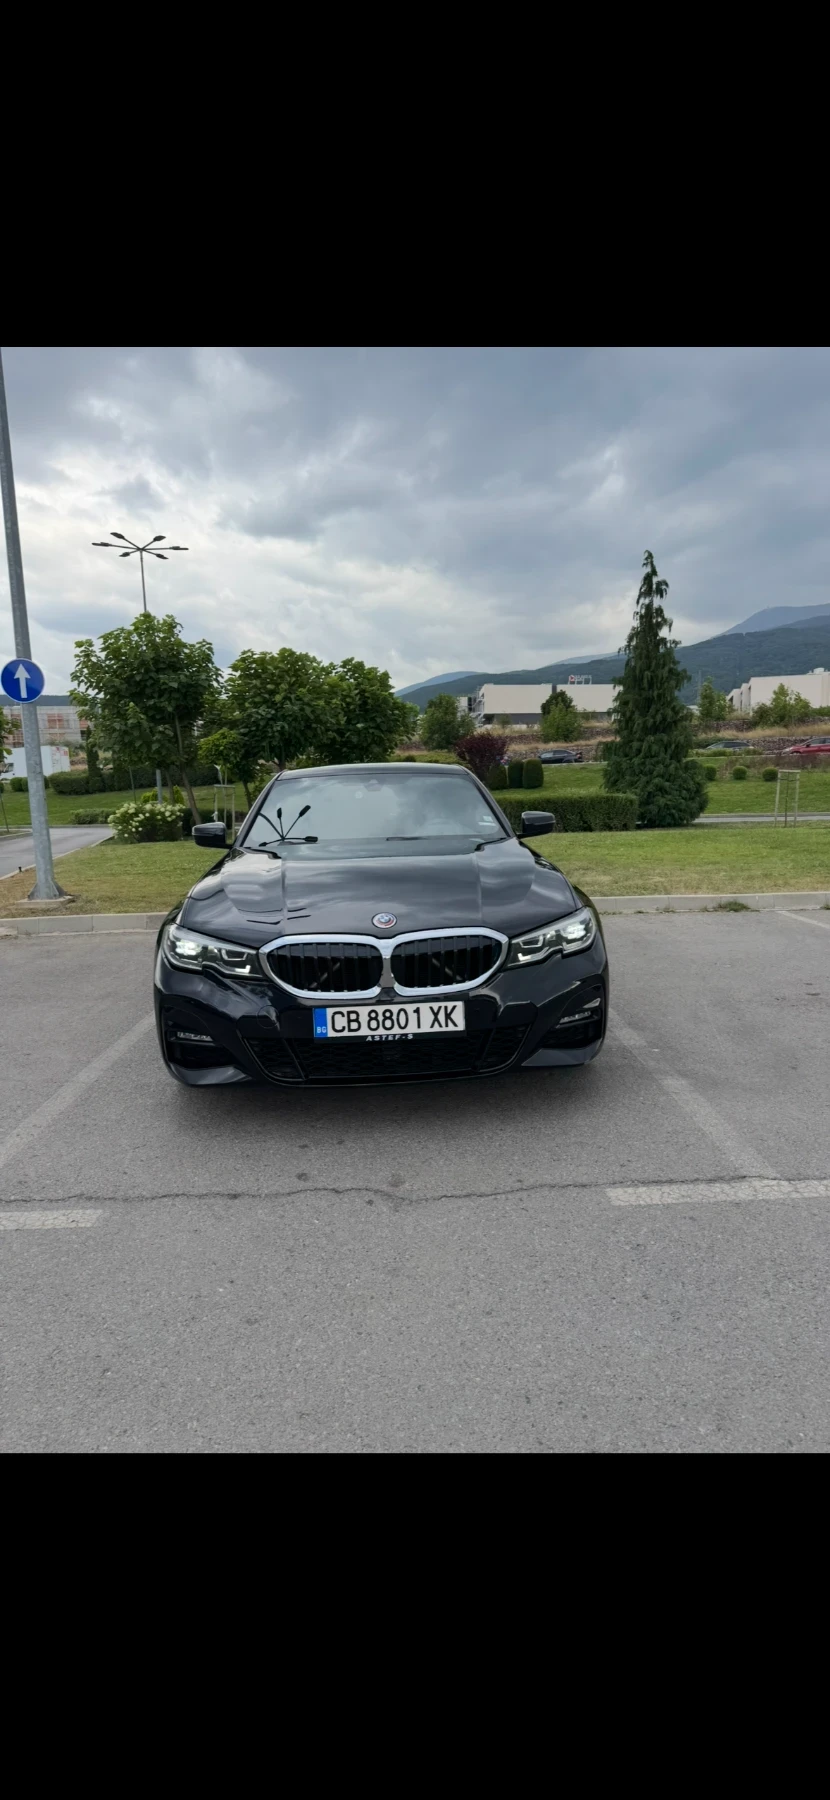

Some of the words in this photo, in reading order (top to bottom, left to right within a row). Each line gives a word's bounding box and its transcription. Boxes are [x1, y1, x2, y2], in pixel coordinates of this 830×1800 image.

[331, 1010, 362, 1033] CB
[367, 1007, 421, 1031] 8801
[429, 1005, 458, 1028] XK
[366, 1033, 414, 1041] ASTEF-S
